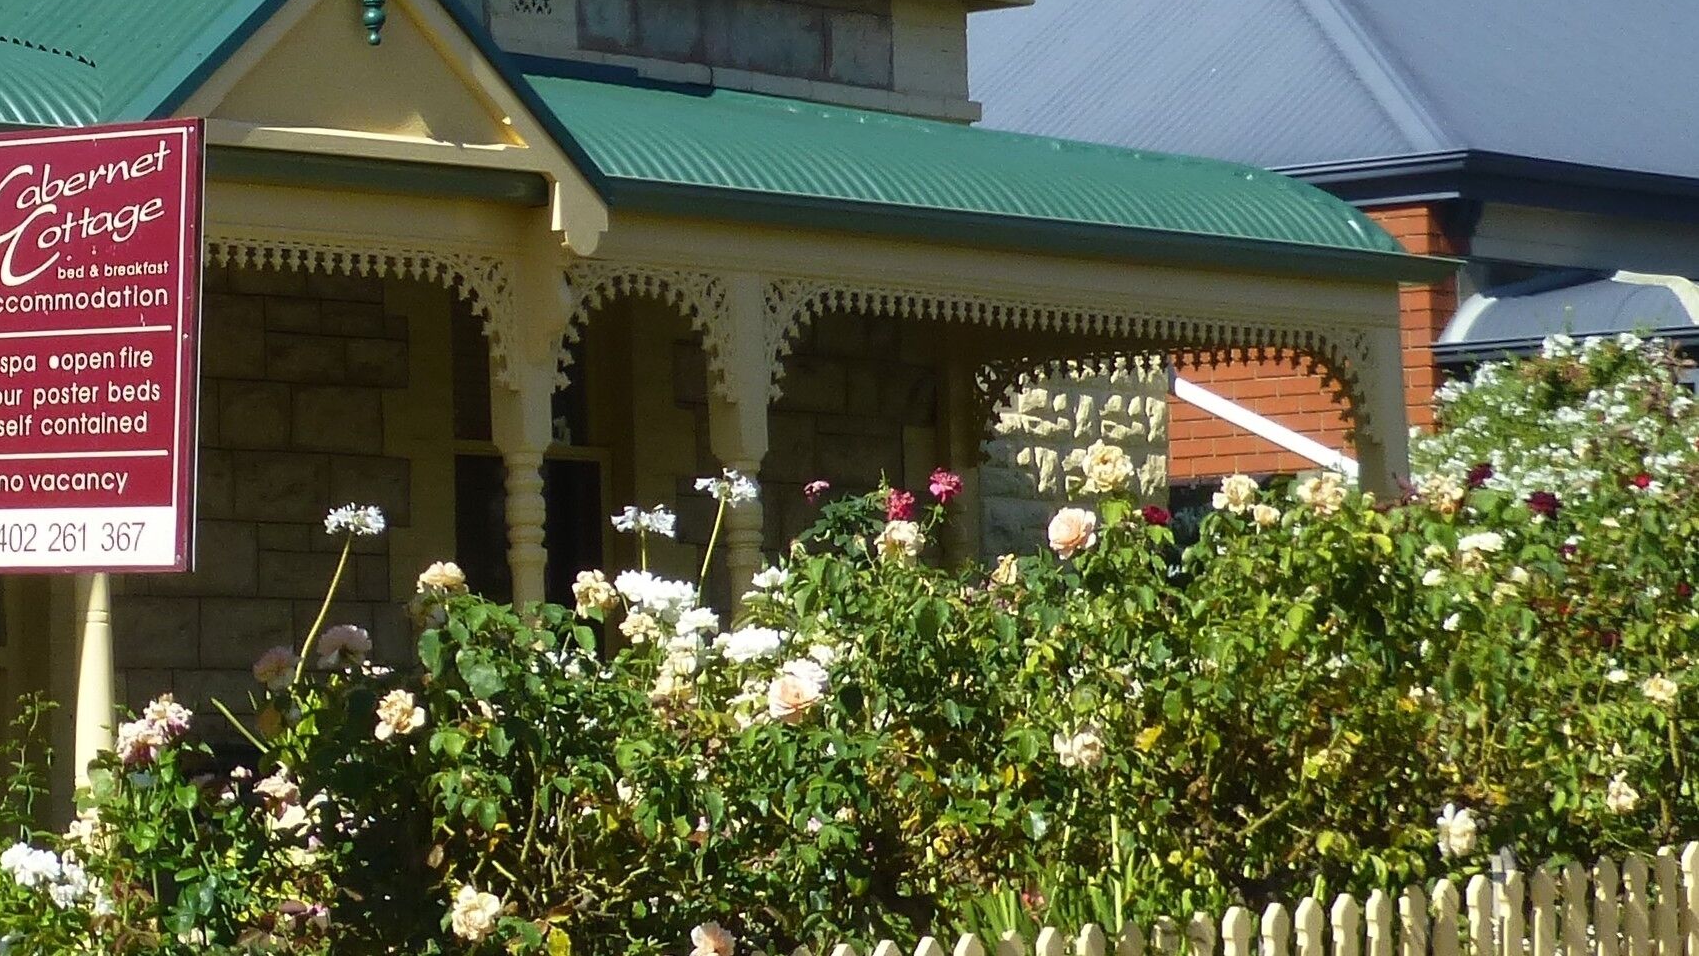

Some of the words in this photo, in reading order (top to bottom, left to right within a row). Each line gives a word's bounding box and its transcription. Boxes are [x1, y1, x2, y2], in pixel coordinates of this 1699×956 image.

[0, 198, 164, 286] Cottage
[57, 264, 84, 280] bed
[89, 264, 99, 278] &
[104, 261, 169, 276] breakfast
[120, 346, 153, 367] fire
[33, 383, 99, 409] poster
[108, 380, 160, 402] beds
[41, 411, 147, 435] contained
[29, 471, 128, 494] vacancy
[48, 523, 86, 551] 261
[101, 522, 145, 551] 367
